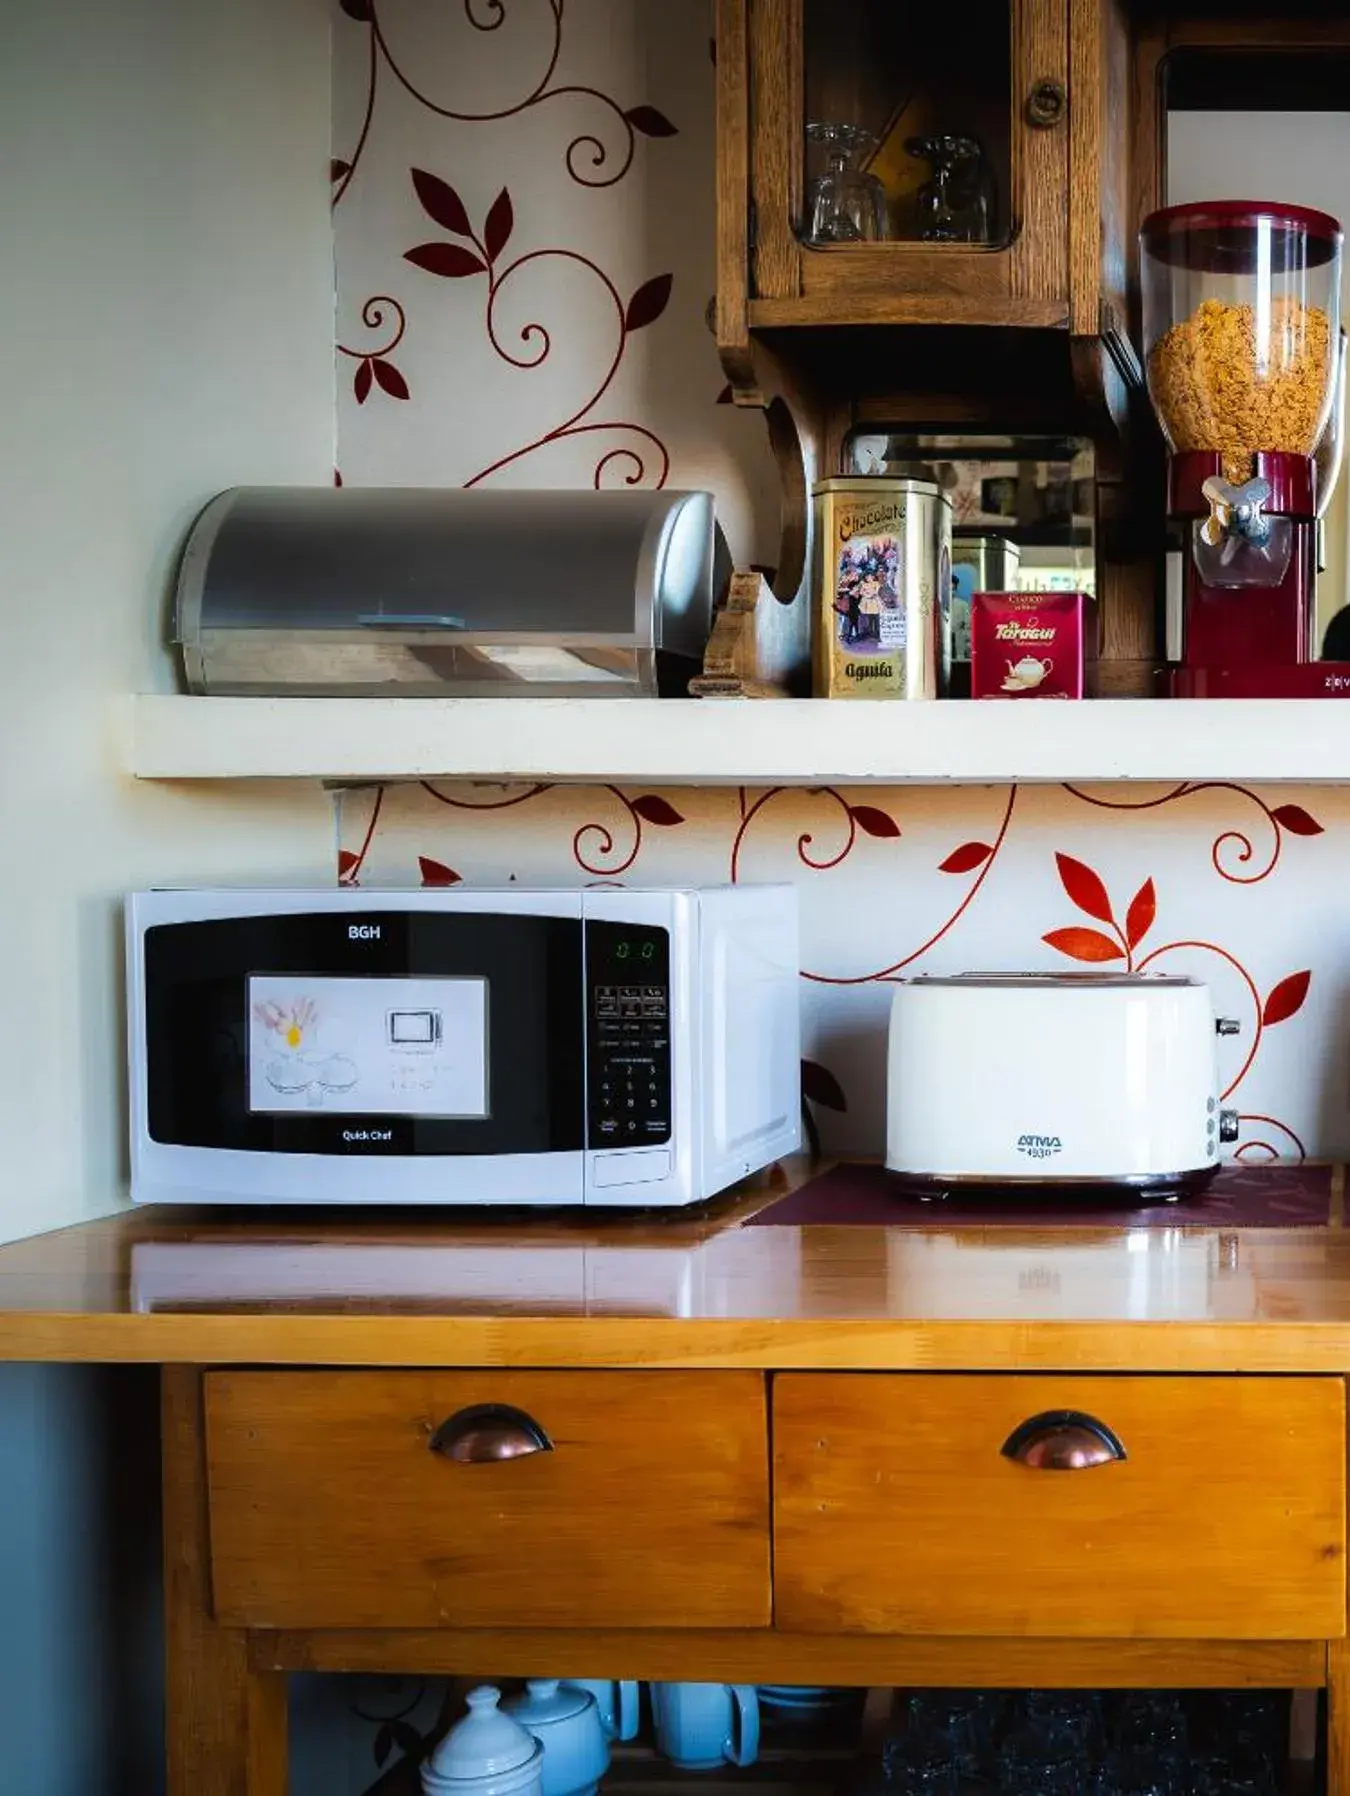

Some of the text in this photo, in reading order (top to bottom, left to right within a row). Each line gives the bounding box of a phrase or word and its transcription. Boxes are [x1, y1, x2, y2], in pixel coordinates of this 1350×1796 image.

[839, 503, 906, 542] Chocolate
[348, 925, 381, 939] BGH
[342, 1130, 370, 1142] Quick
